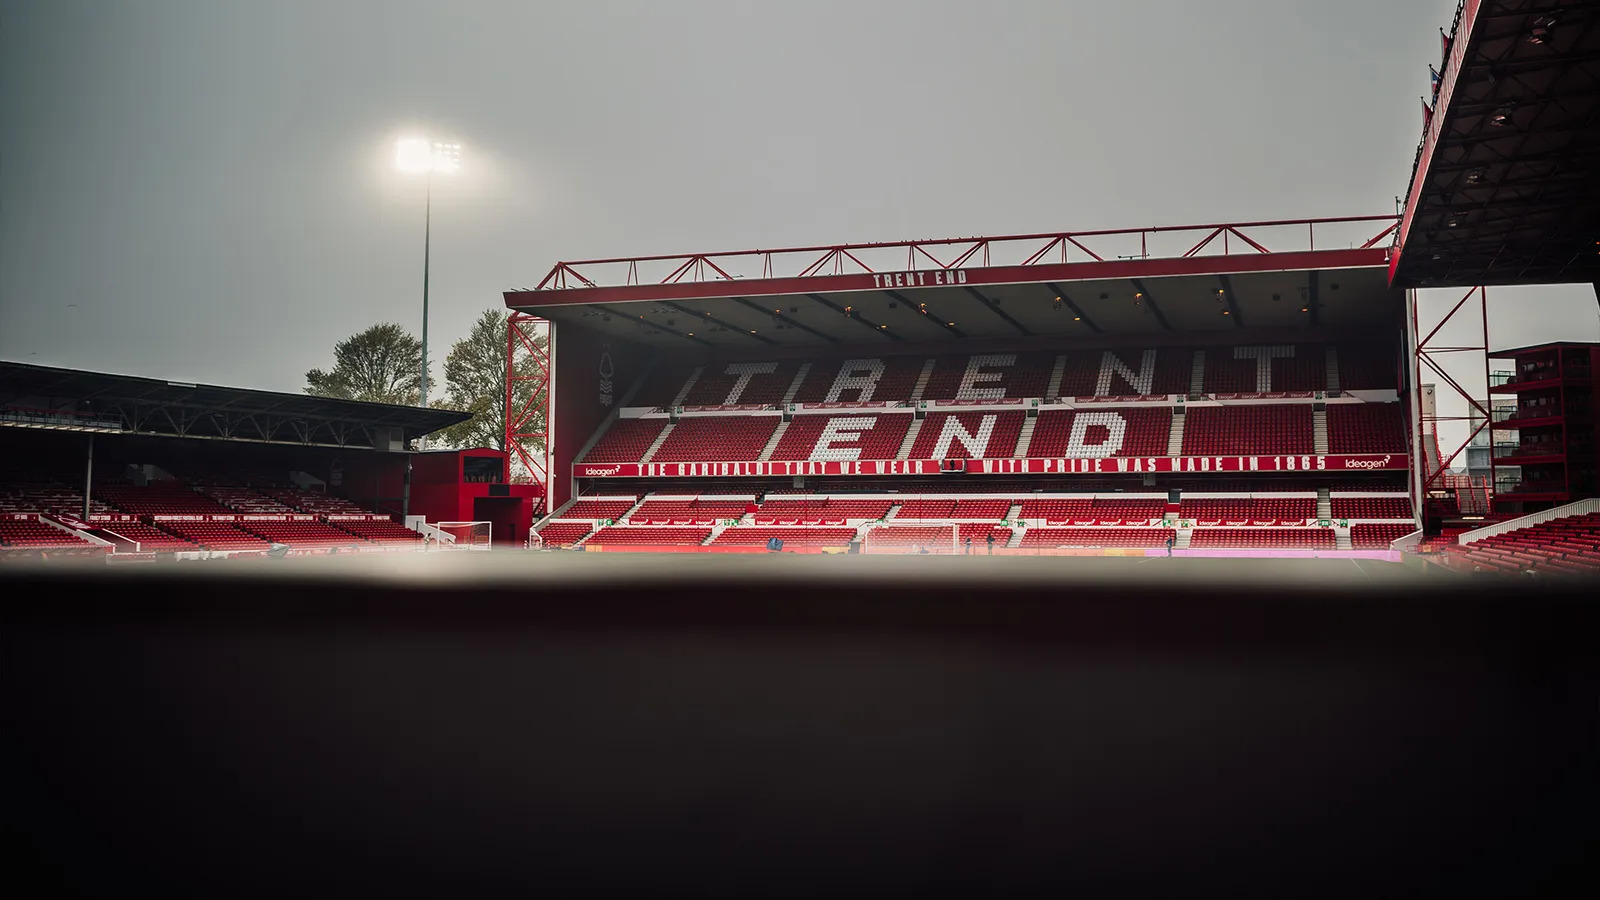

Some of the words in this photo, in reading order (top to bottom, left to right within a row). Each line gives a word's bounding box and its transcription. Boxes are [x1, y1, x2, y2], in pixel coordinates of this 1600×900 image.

[873, 272, 925, 288] TRENT
[935, 270, 967, 285] END
[724, 345, 1296, 405] TRENT
[807, 411, 1127, 461] END
[585, 467, 616, 477] Ideagen
[637, 463, 665, 476] THE
[678, 462, 772, 476] GARIBALDI
[784, 461, 826, 475] THAT
[840, 461, 861, 475] WE
[875, 460, 923, 474] WEAR
[982, 459, 1029, 473] WITH
[1043, 458, 1102, 472] PRIDE
[1116, 458, 1156, 472] WAS
[1171, 457, 1223, 471] MADE
[1238, 457, 1259, 471] IN
[1274, 456, 1326, 470] 1865
[1345, 458, 1386, 470] Ideagen
